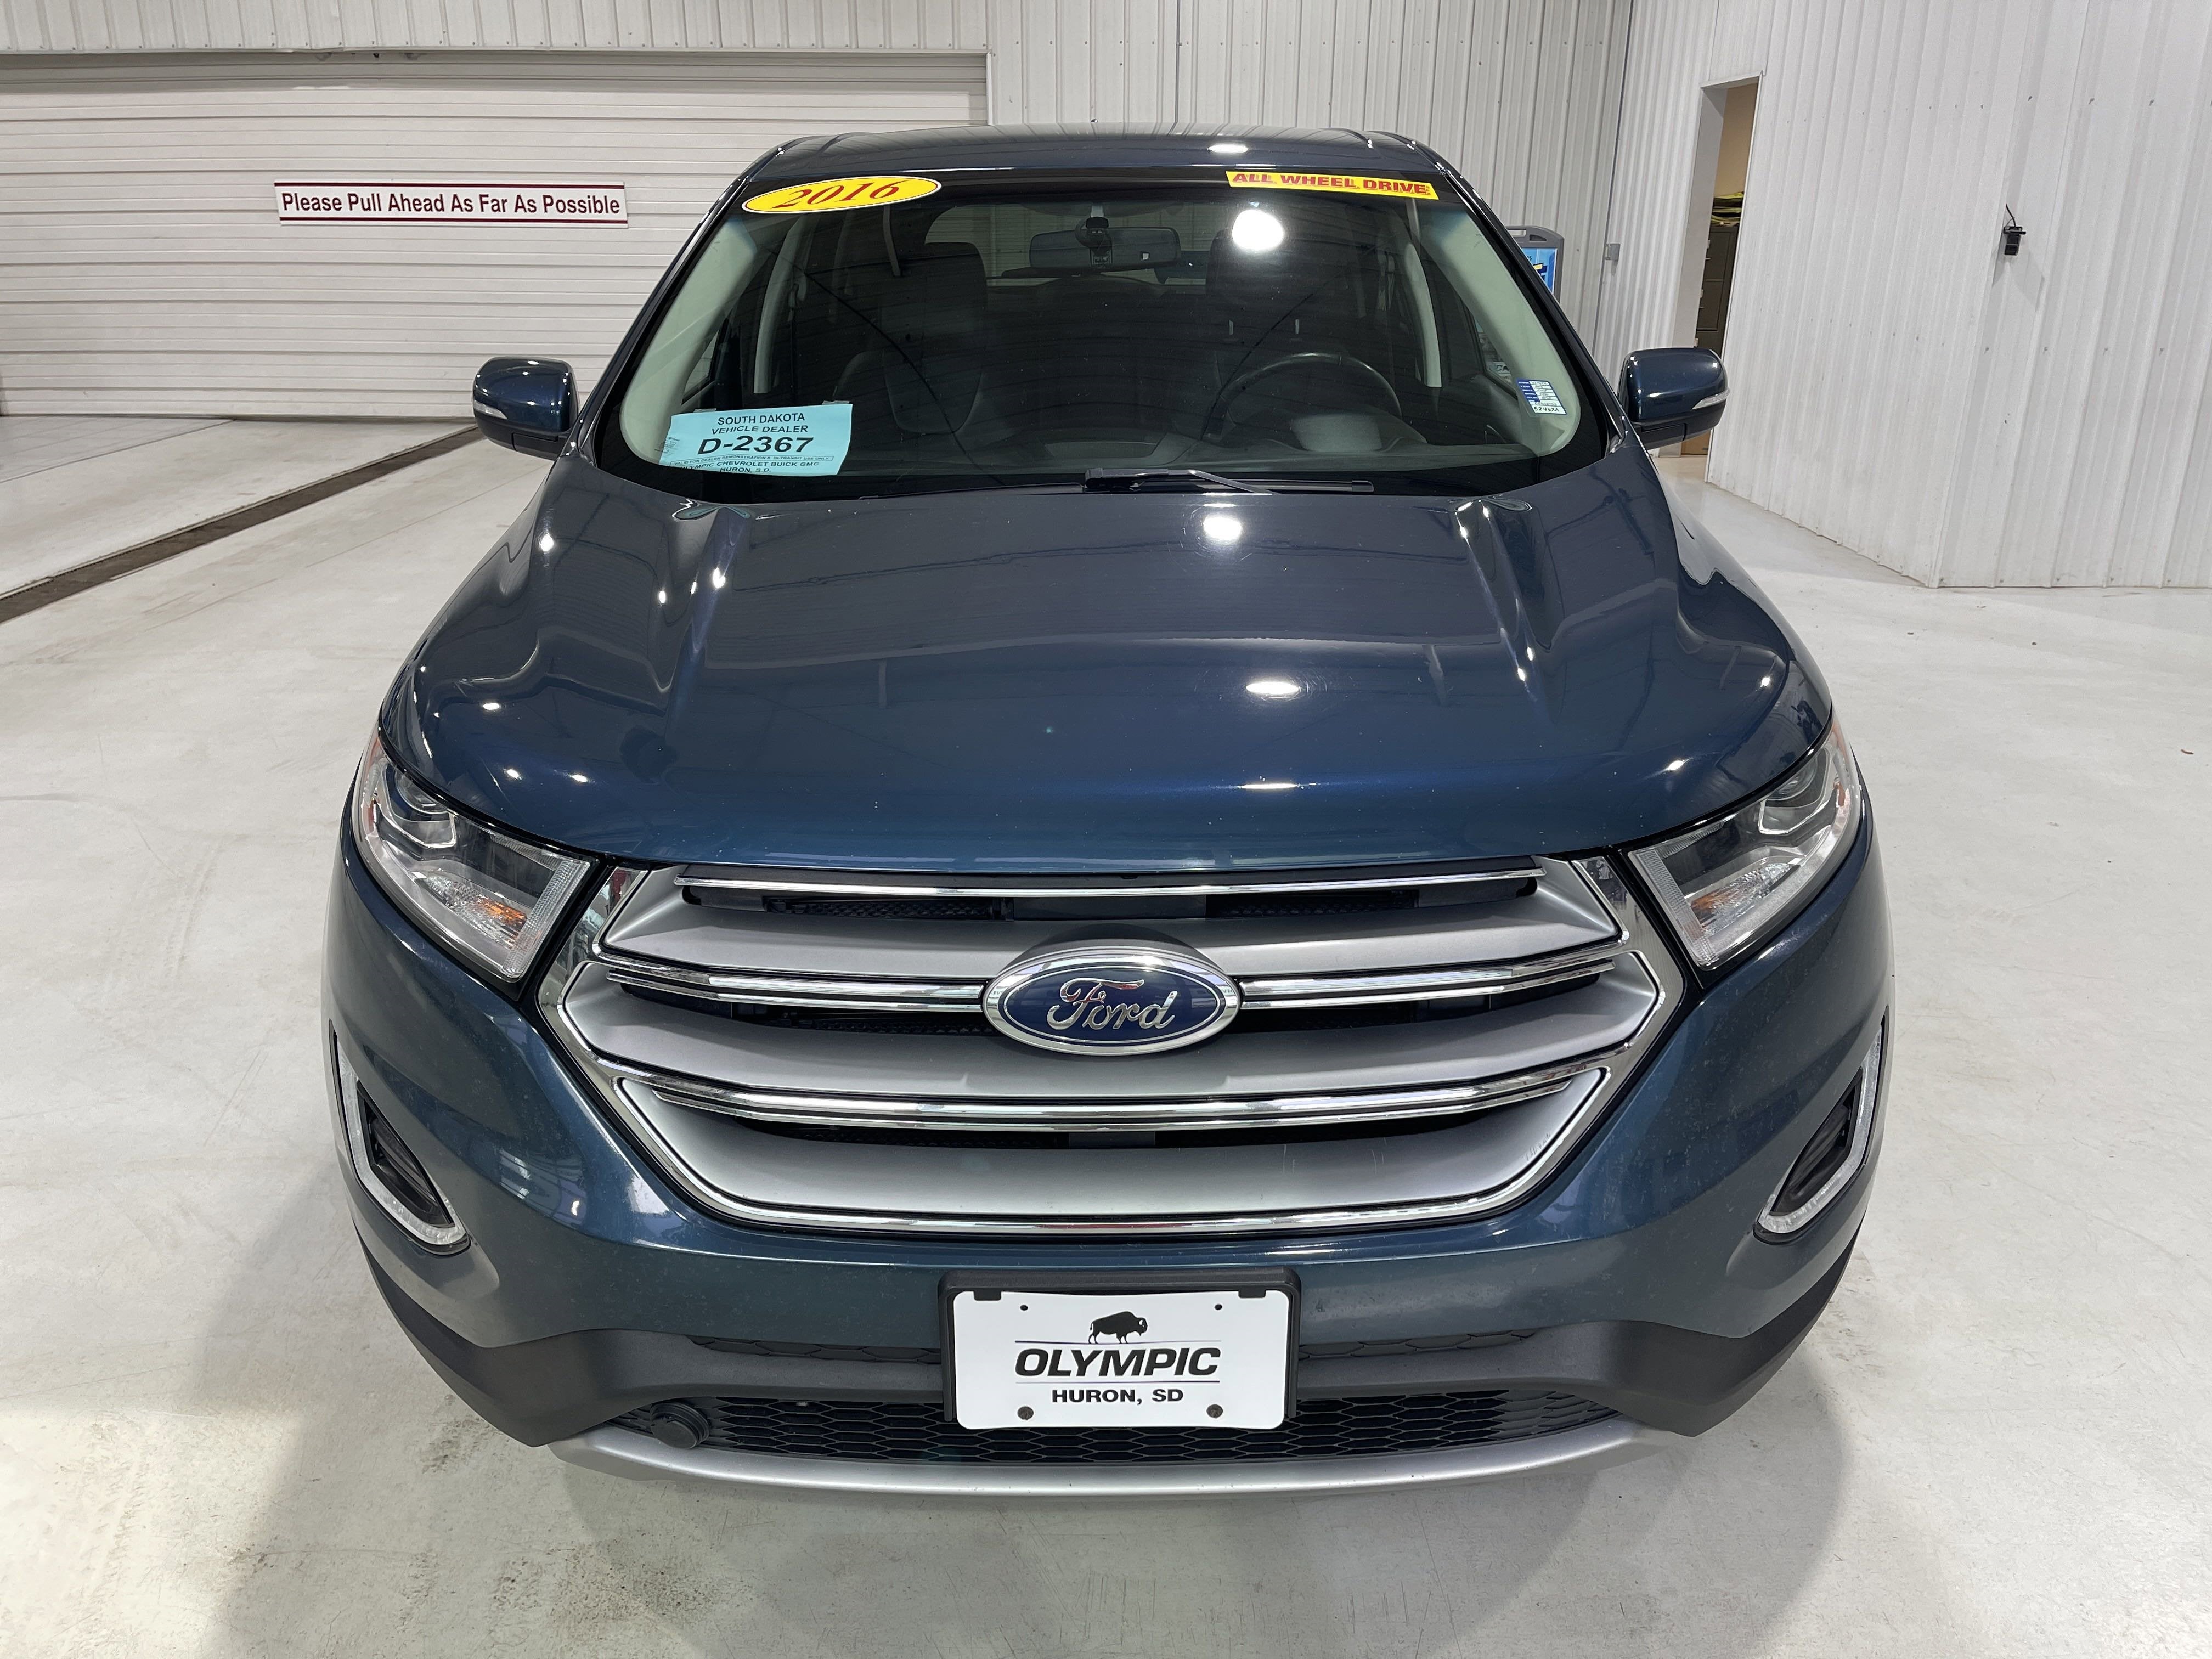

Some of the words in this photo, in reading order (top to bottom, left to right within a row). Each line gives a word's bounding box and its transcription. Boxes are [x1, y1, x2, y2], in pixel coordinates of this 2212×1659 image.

[1233, 173, 1275, 183] ALL
[1280, 175, 1358, 188] WHEEL
[1363, 179, 1428, 194] DRIVE
[281, 193, 342, 211] Please
[347, 193, 382, 211] Pull
[388, 193, 444, 212] Ahead
[451, 194, 474, 212] As
[479, 194, 507, 212] Far
[515, 194, 537, 213] As
[543, 195, 620, 213] Possible
[770, 179, 911, 209] 2016
[718, 415, 755, 425] SOUTH
[760, 413, 805, 424] DAKOTA
[712, 425, 759, 435] VEHICLE
[697, 435, 814, 455] D-2367
[1047, 977, 1177, 1030] Ford
[1015, 1347, 1221, 1377] OLYMPIC
[1052, 1389, 1142, 1405] HURON,
[1152, 1389, 1183, 1402] SD
